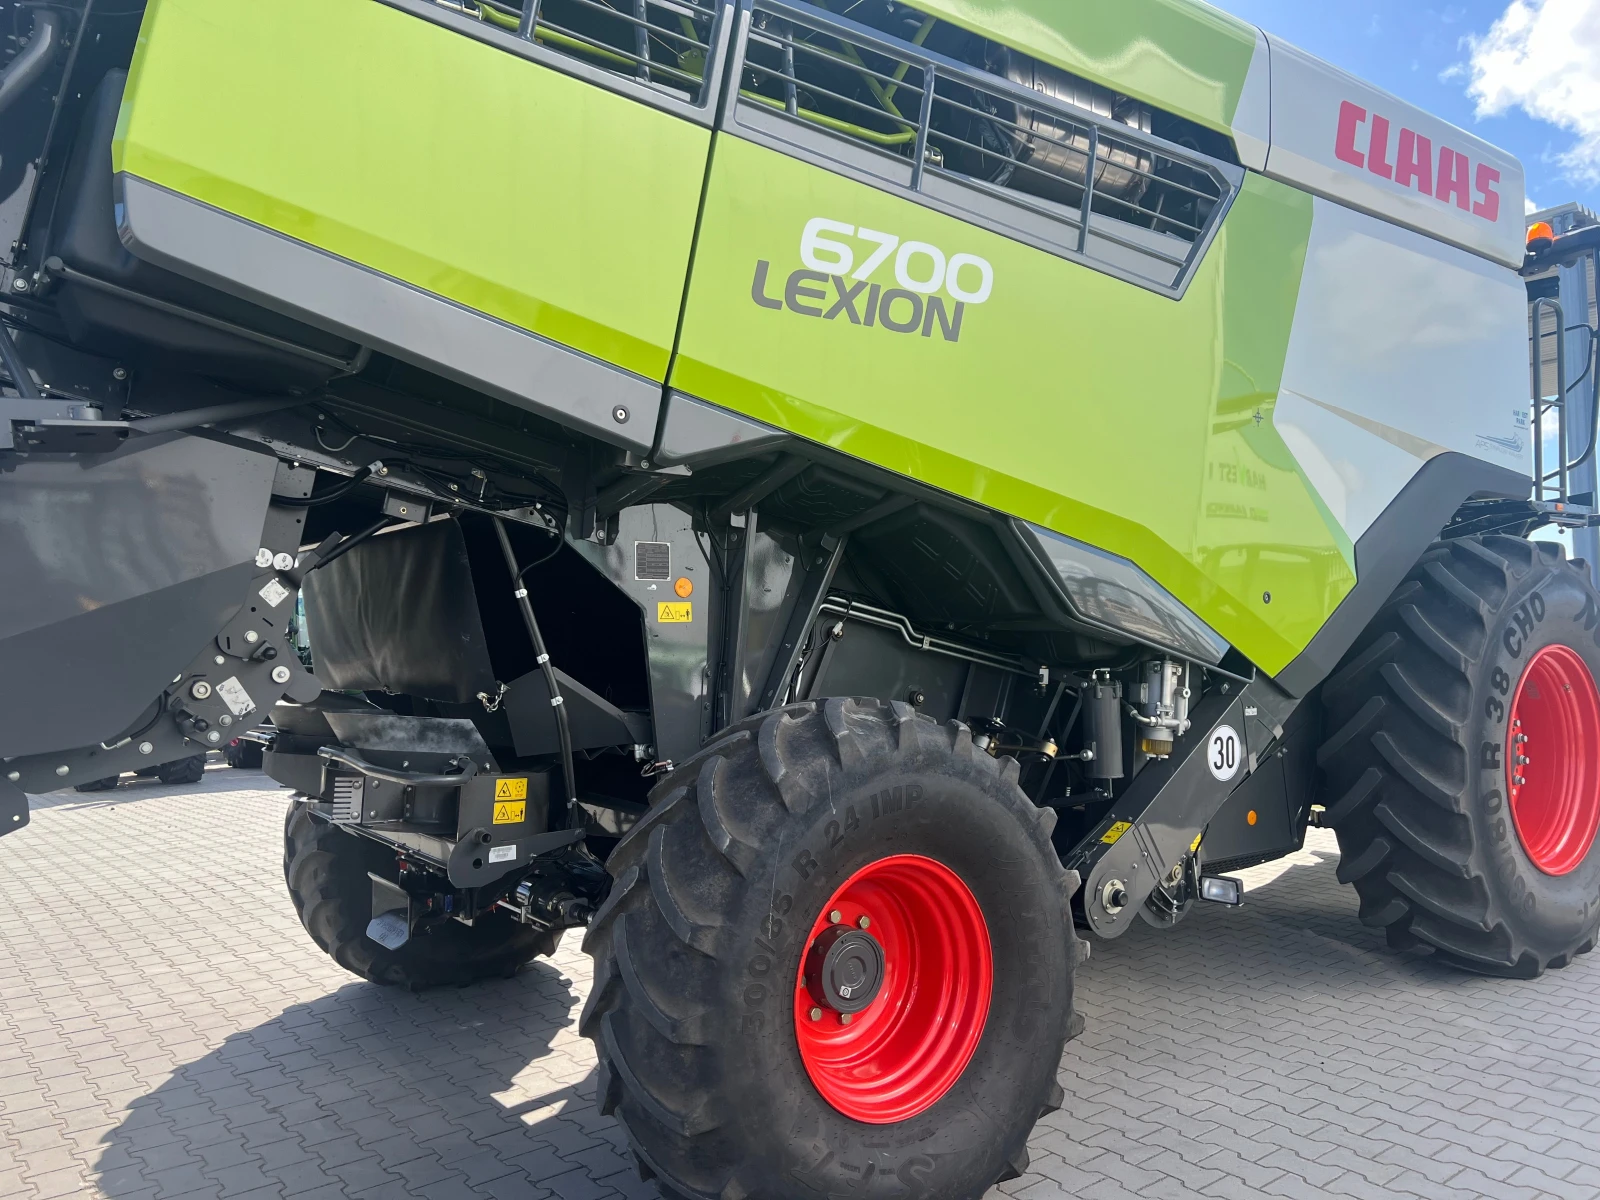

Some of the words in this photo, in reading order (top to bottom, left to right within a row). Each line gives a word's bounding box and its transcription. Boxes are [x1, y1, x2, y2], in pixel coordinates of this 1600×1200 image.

[1335, 100, 1500, 222] CLAAS
[800, 217, 994, 304] 6700
[751, 259, 965, 343] LEXION
[1503, 591, 1546, 659] CHO
[1485, 665, 1510, 723] 38
[1213, 735, 1235, 770] 30
[1480, 741, 1501, 769] R
[741, 889, 794, 1035] 500/85
[791, 848, 819, 882] R
[823, 805, 860, 850] 24
[869, 784, 924, 820] IMP
